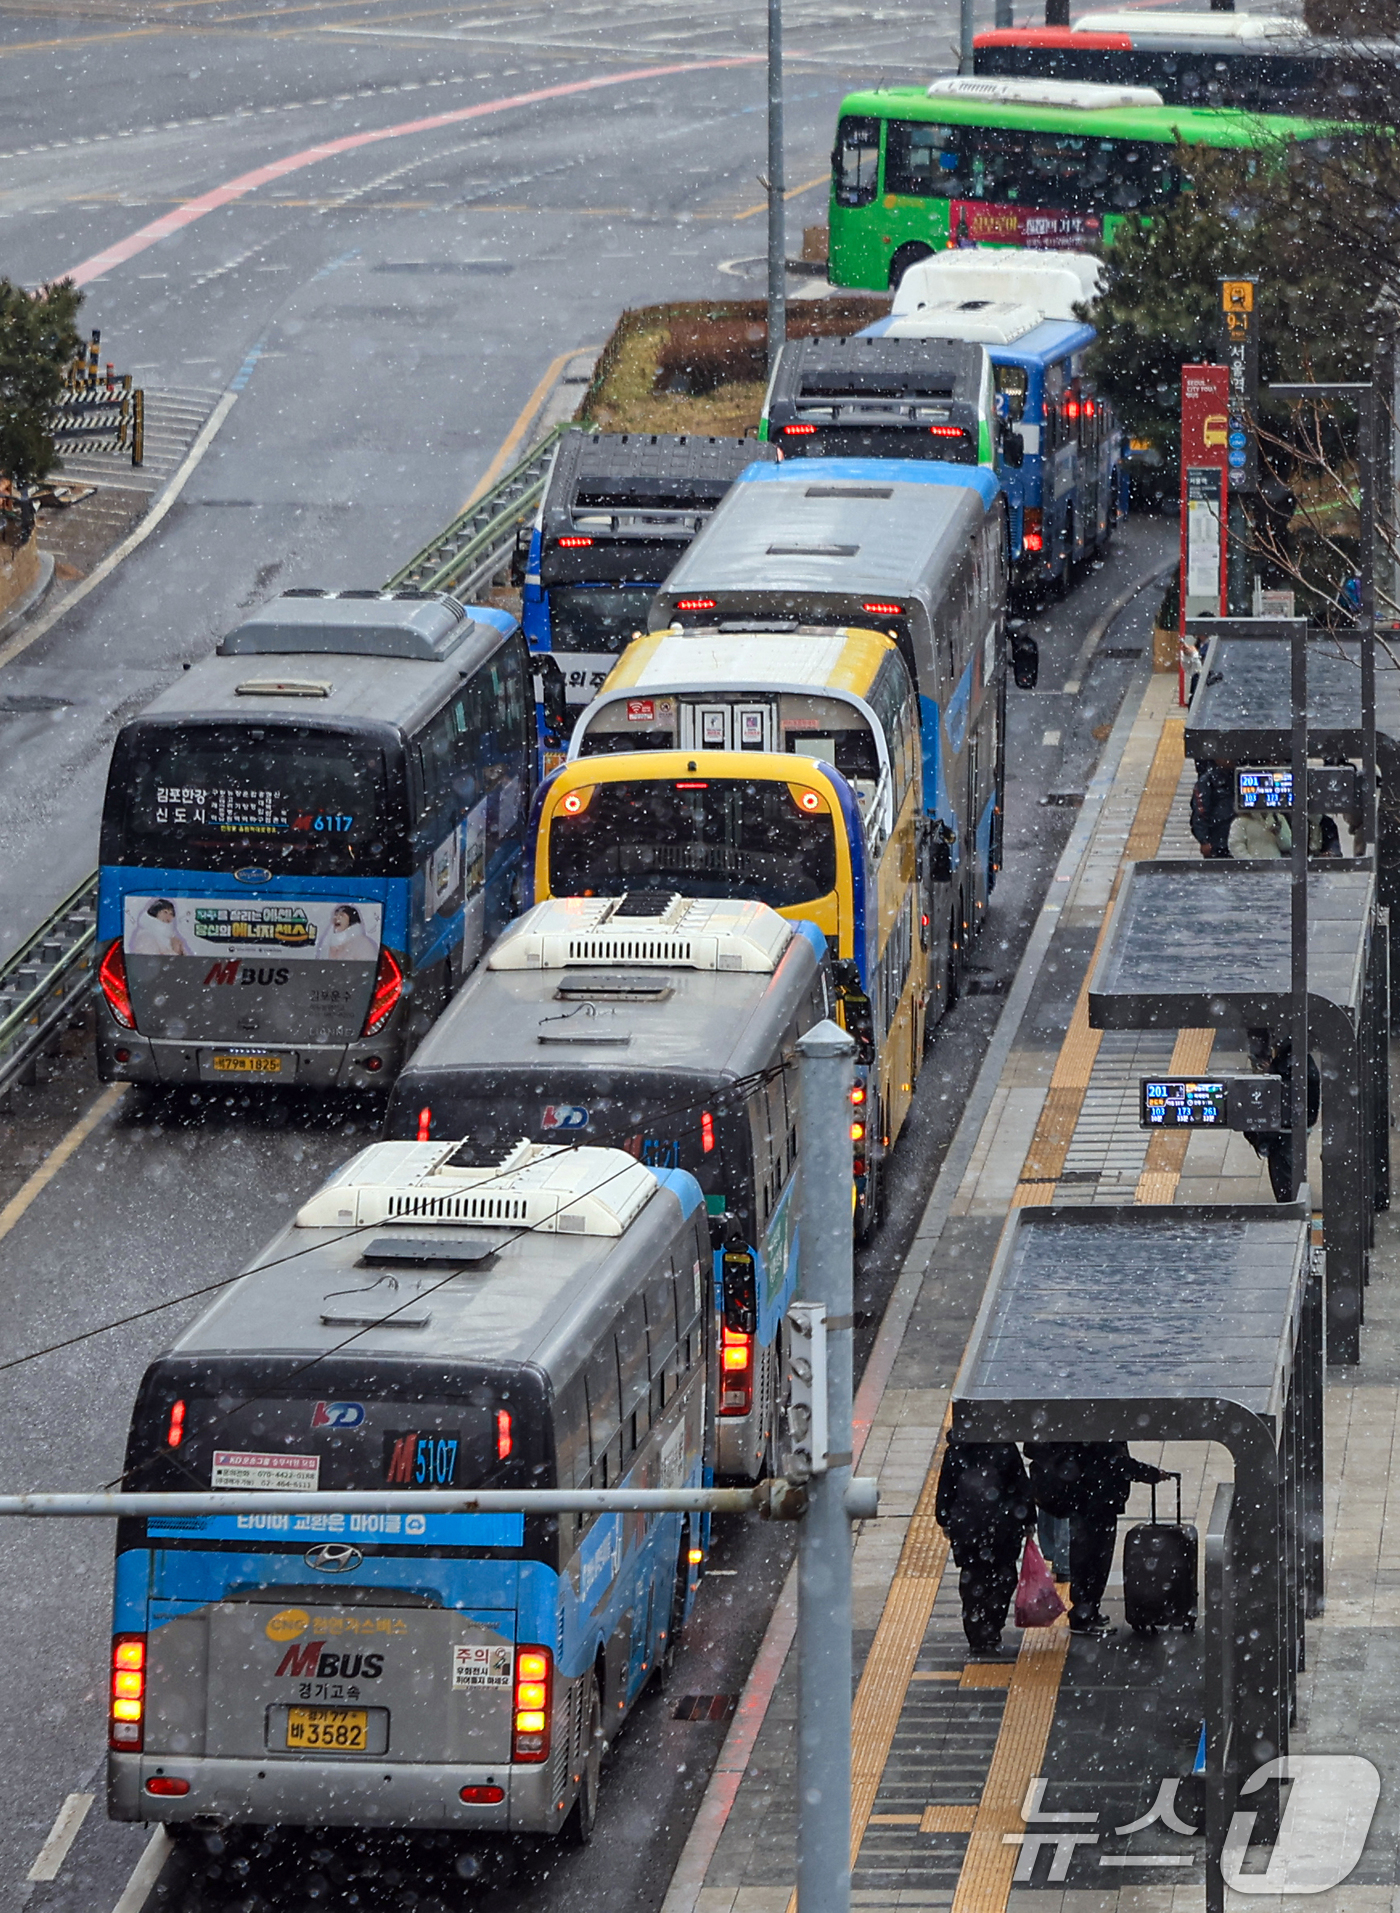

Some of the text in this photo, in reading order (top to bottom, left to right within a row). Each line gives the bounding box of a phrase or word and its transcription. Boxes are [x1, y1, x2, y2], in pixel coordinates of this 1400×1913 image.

[1227, 313, 1248, 330] 9-1
[1230, 345, 1246, 393] 서울역
[1242, 777, 1259, 786] 201
[157, 788, 207, 804] 김포한강
[249, 1058, 278, 1071] 1825
[1148, 1086, 1168, 1097] 201
[1151, 1107, 1217, 1116] 103 173 261
[293, 1513, 345, 1532] 교환은
[350, 1513, 402, 1533] 마이클
[313, 1616, 408, 1635] 천연가스버스
[274, 1640, 385, 1679] MBUS
[456, 1648, 489, 1665] 주의
[299, 1682, 361, 1700] 경기고속
